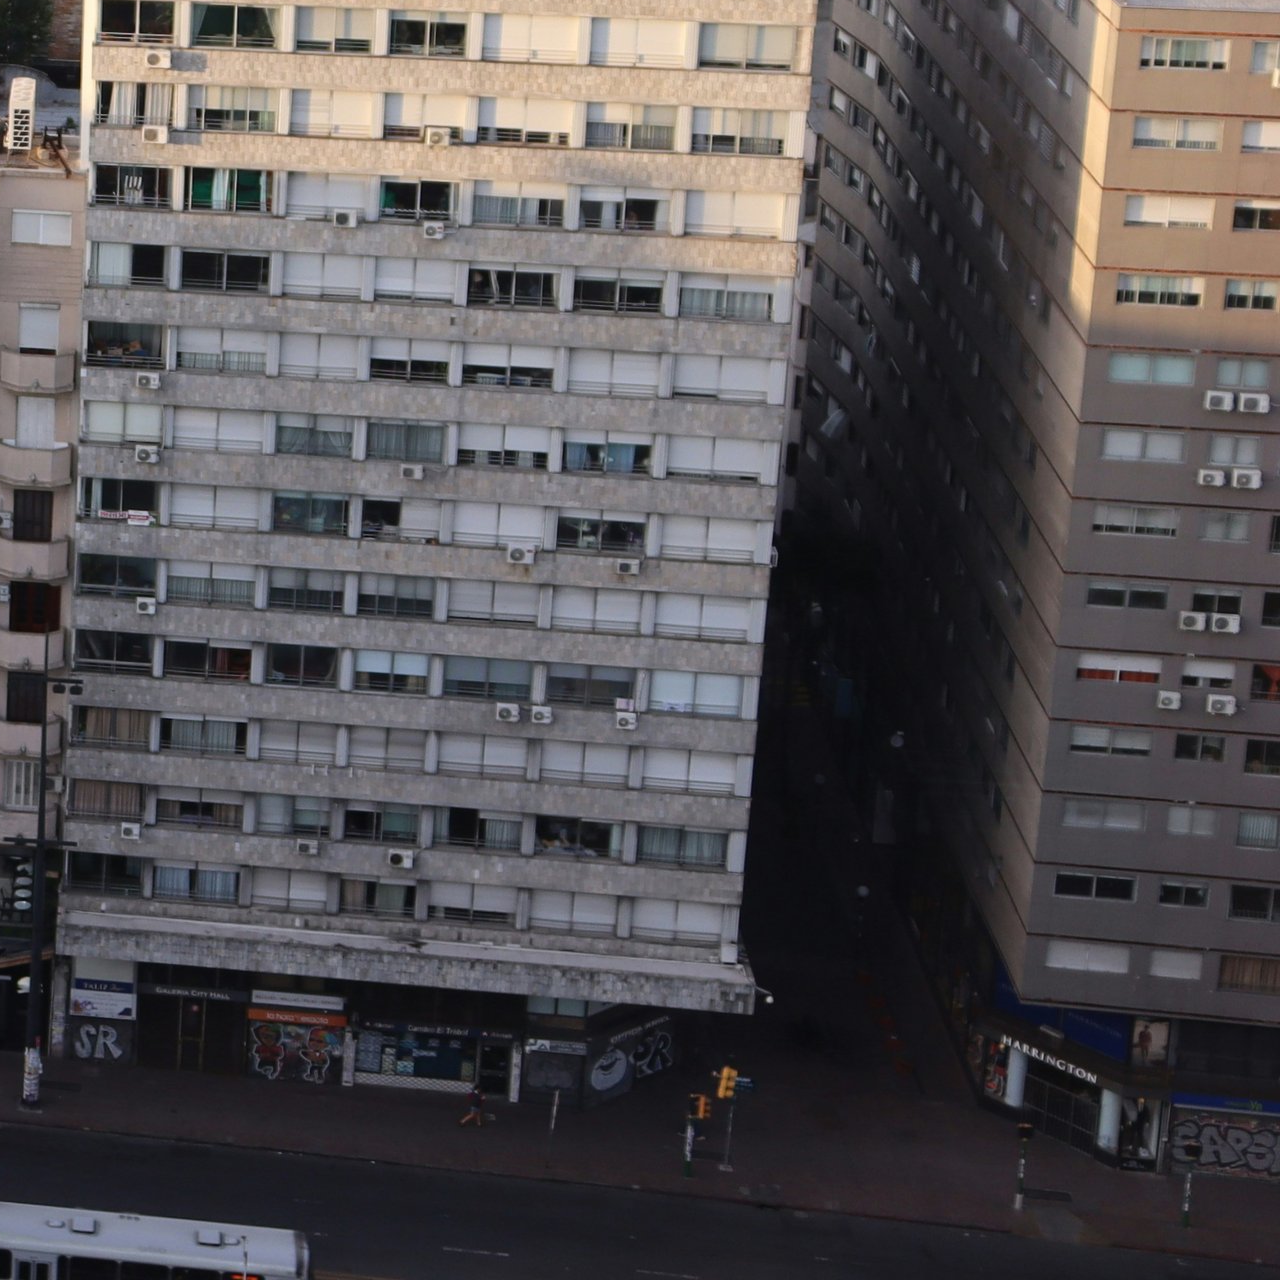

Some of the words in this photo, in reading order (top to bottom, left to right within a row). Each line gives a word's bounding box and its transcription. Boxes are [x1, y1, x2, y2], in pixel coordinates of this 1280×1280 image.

[155, 986, 189, 996] GALERIA
[190, 989, 208, 998] CITY
[210, 991, 230, 1000] HALL
[276, 1013, 295, 1022] hora
[408, 1024, 435, 1033] Cambio
[74, 1024, 123, 1060] SR
[1001, 1034, 1098, 1084] HARRINGTON
